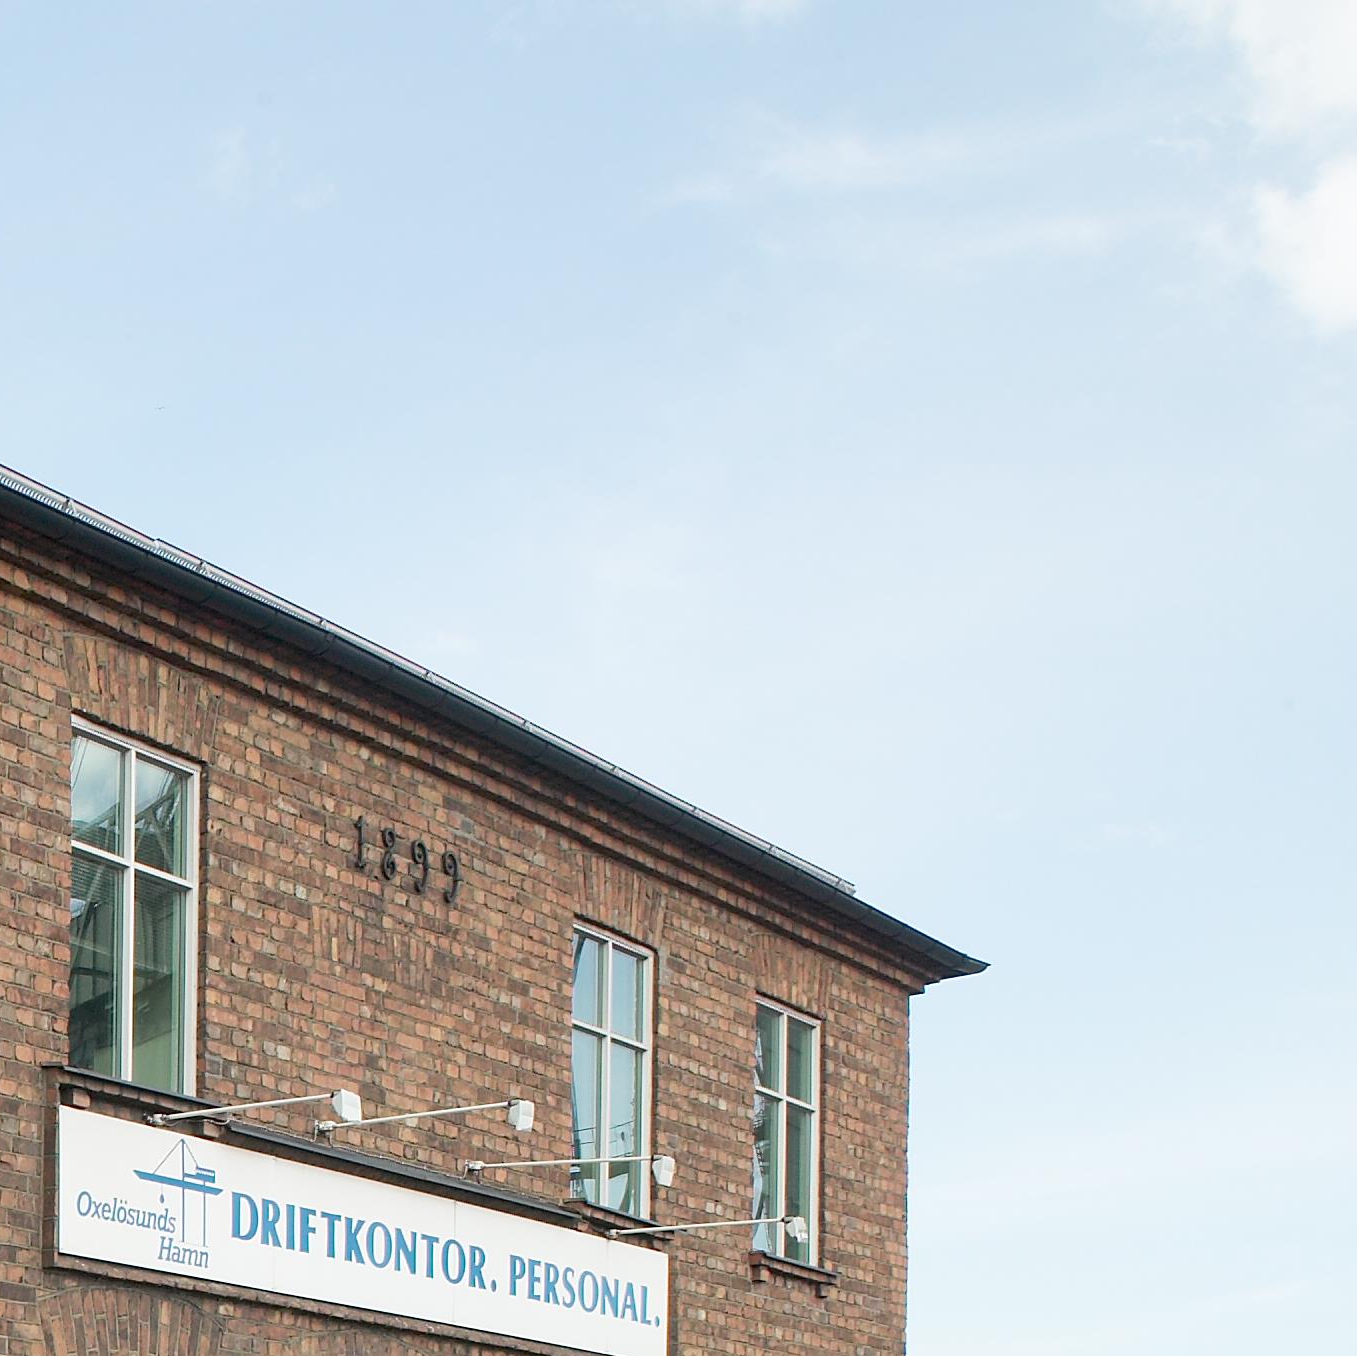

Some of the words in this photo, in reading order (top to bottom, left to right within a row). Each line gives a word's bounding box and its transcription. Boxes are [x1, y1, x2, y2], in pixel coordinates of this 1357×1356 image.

[355, 815, 461, 903] 1899
[77, 1191, 176, 1233] Oxelösunds
[158, 1236, 209, 1268] Hamn
[231, 1191, 497, 1292] DRIFTKONTOR.
[509, 1254, 660, 1327] PERSONAL.
